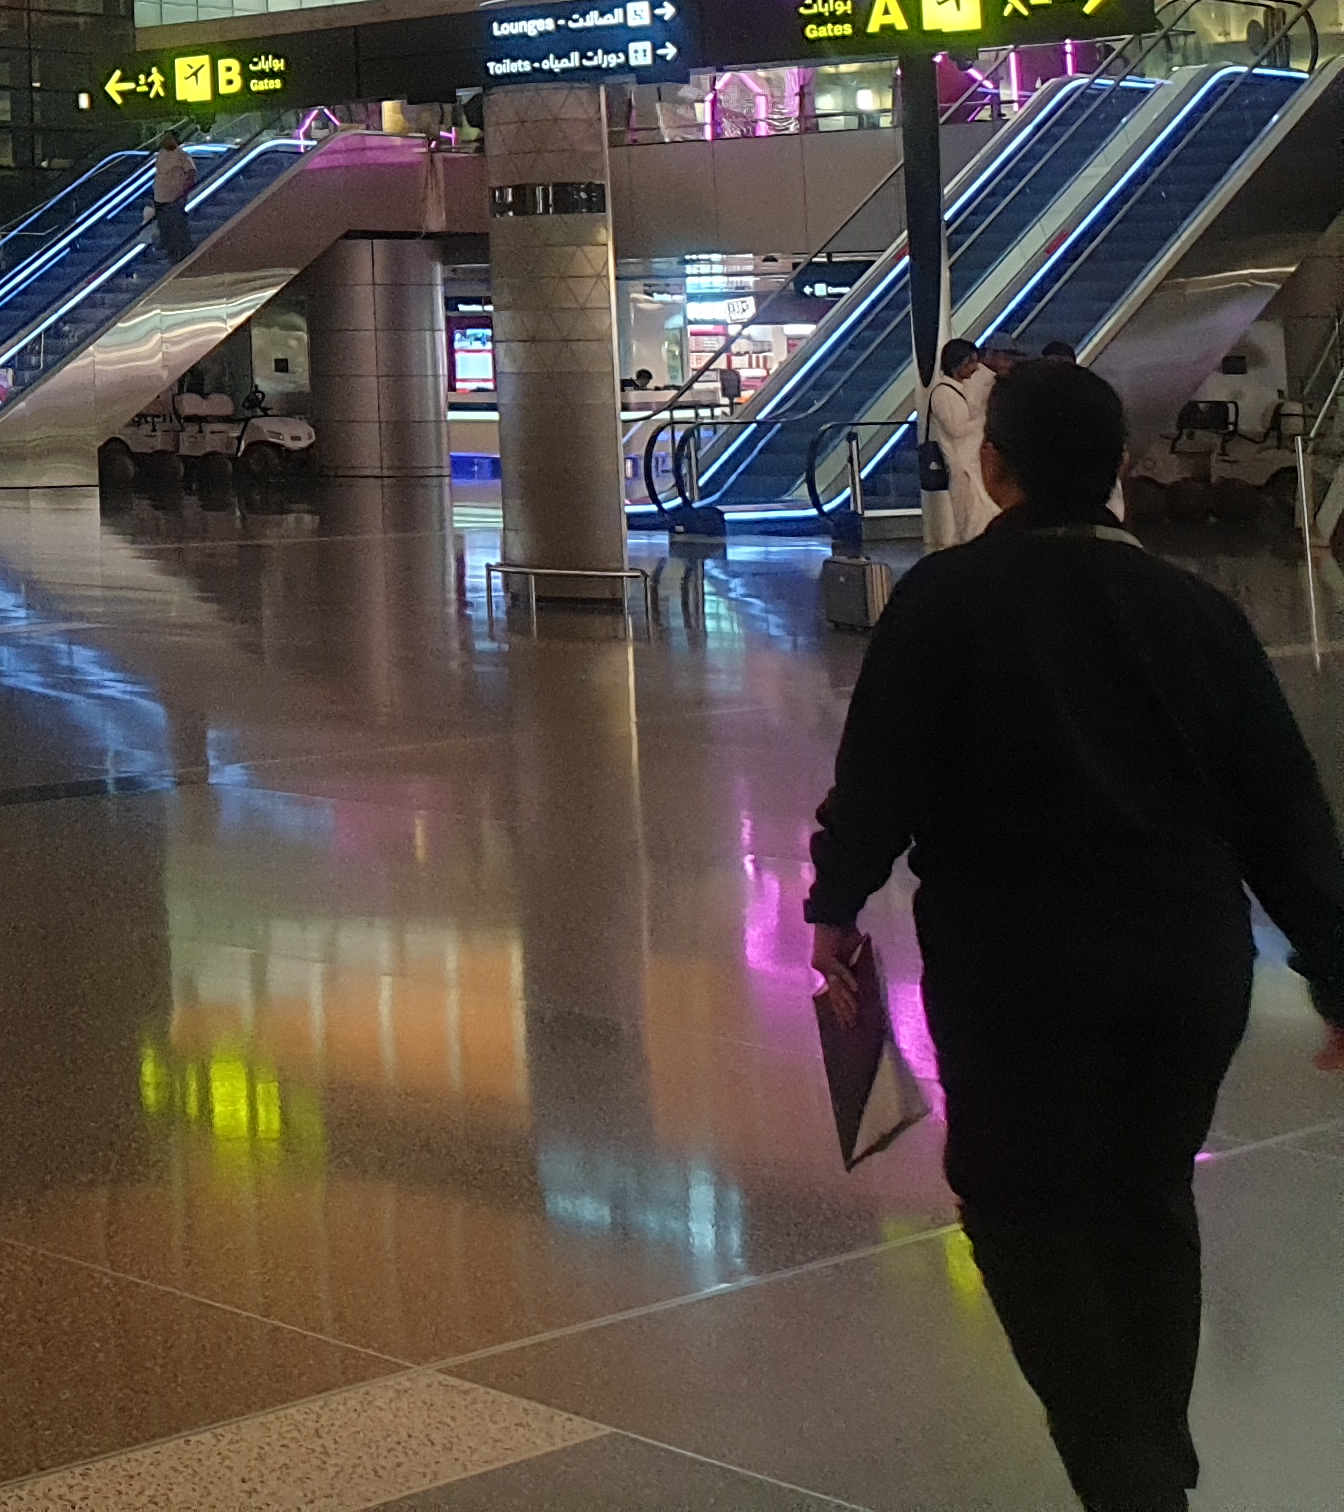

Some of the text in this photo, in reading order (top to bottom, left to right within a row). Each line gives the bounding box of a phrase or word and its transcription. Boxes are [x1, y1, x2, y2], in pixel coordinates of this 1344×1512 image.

[492, 17, 555, 37] Lounges
[567, 8, 624, 29] الصالات
[805, 22, 853, 40] Gates
[248, 54, 285, 72] بوابات
[487, 58, 532, 75] Toilets
[542, 51, 580, 73] المياه
[581, 48, 625, 68] دورات
[218, 58, 244, 95] B
[250, 77, 282, 92] Gates
